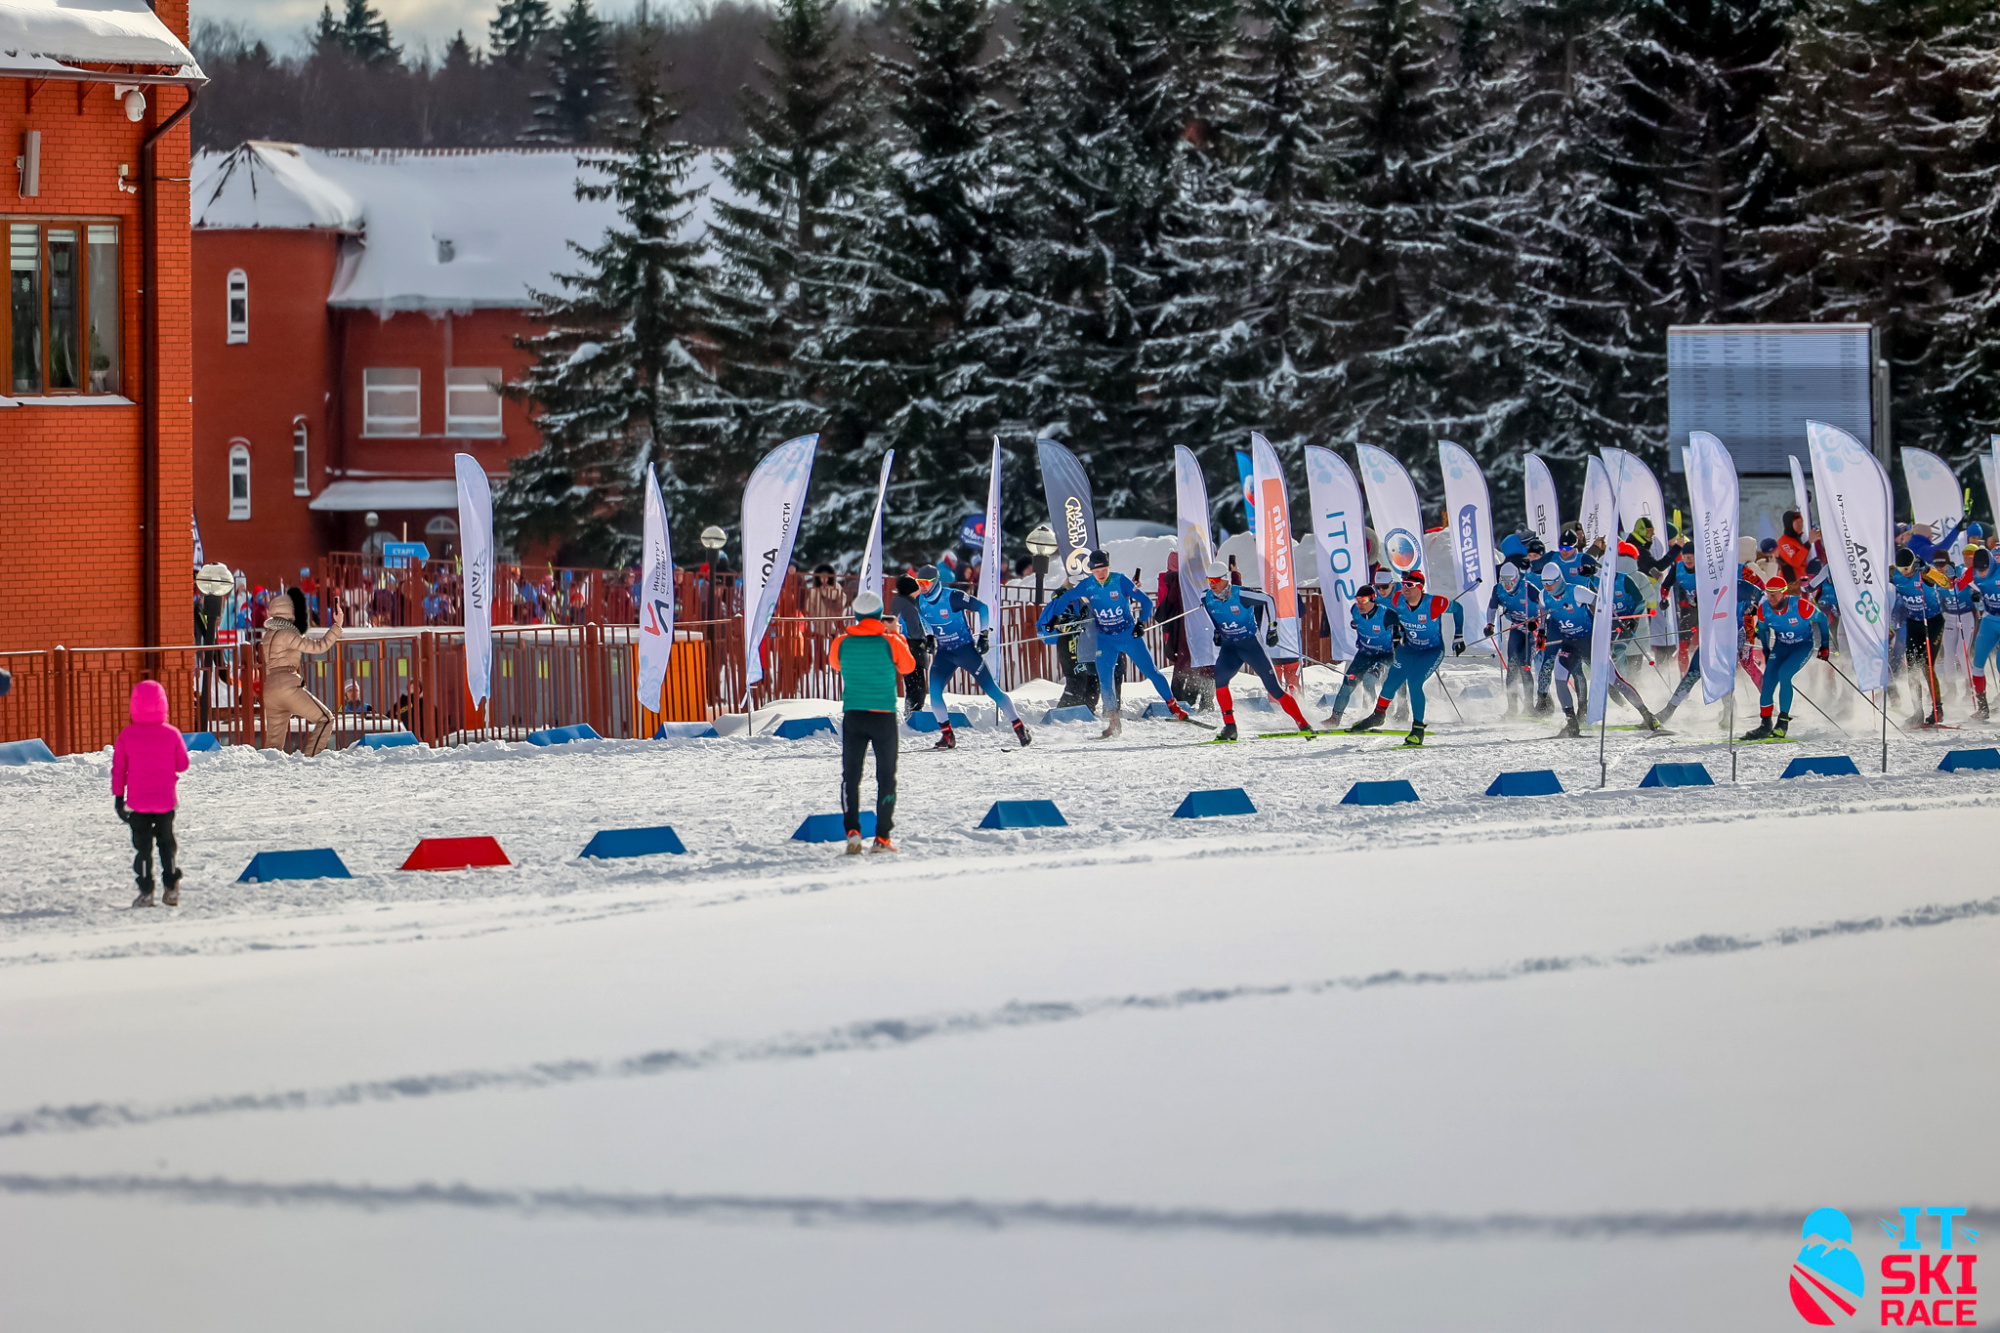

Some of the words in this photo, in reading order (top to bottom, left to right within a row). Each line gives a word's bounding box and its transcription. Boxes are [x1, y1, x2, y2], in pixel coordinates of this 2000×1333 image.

[1093, 606, 1123, 619] 1416
[1222, 621, 1238, 629] 14
[1558, 620, 1574, 628] 16
[937, 626, 946, 635] 2
[1409, 631, 1417, 639] 9
[1779, 631, 1795, 639] 19
